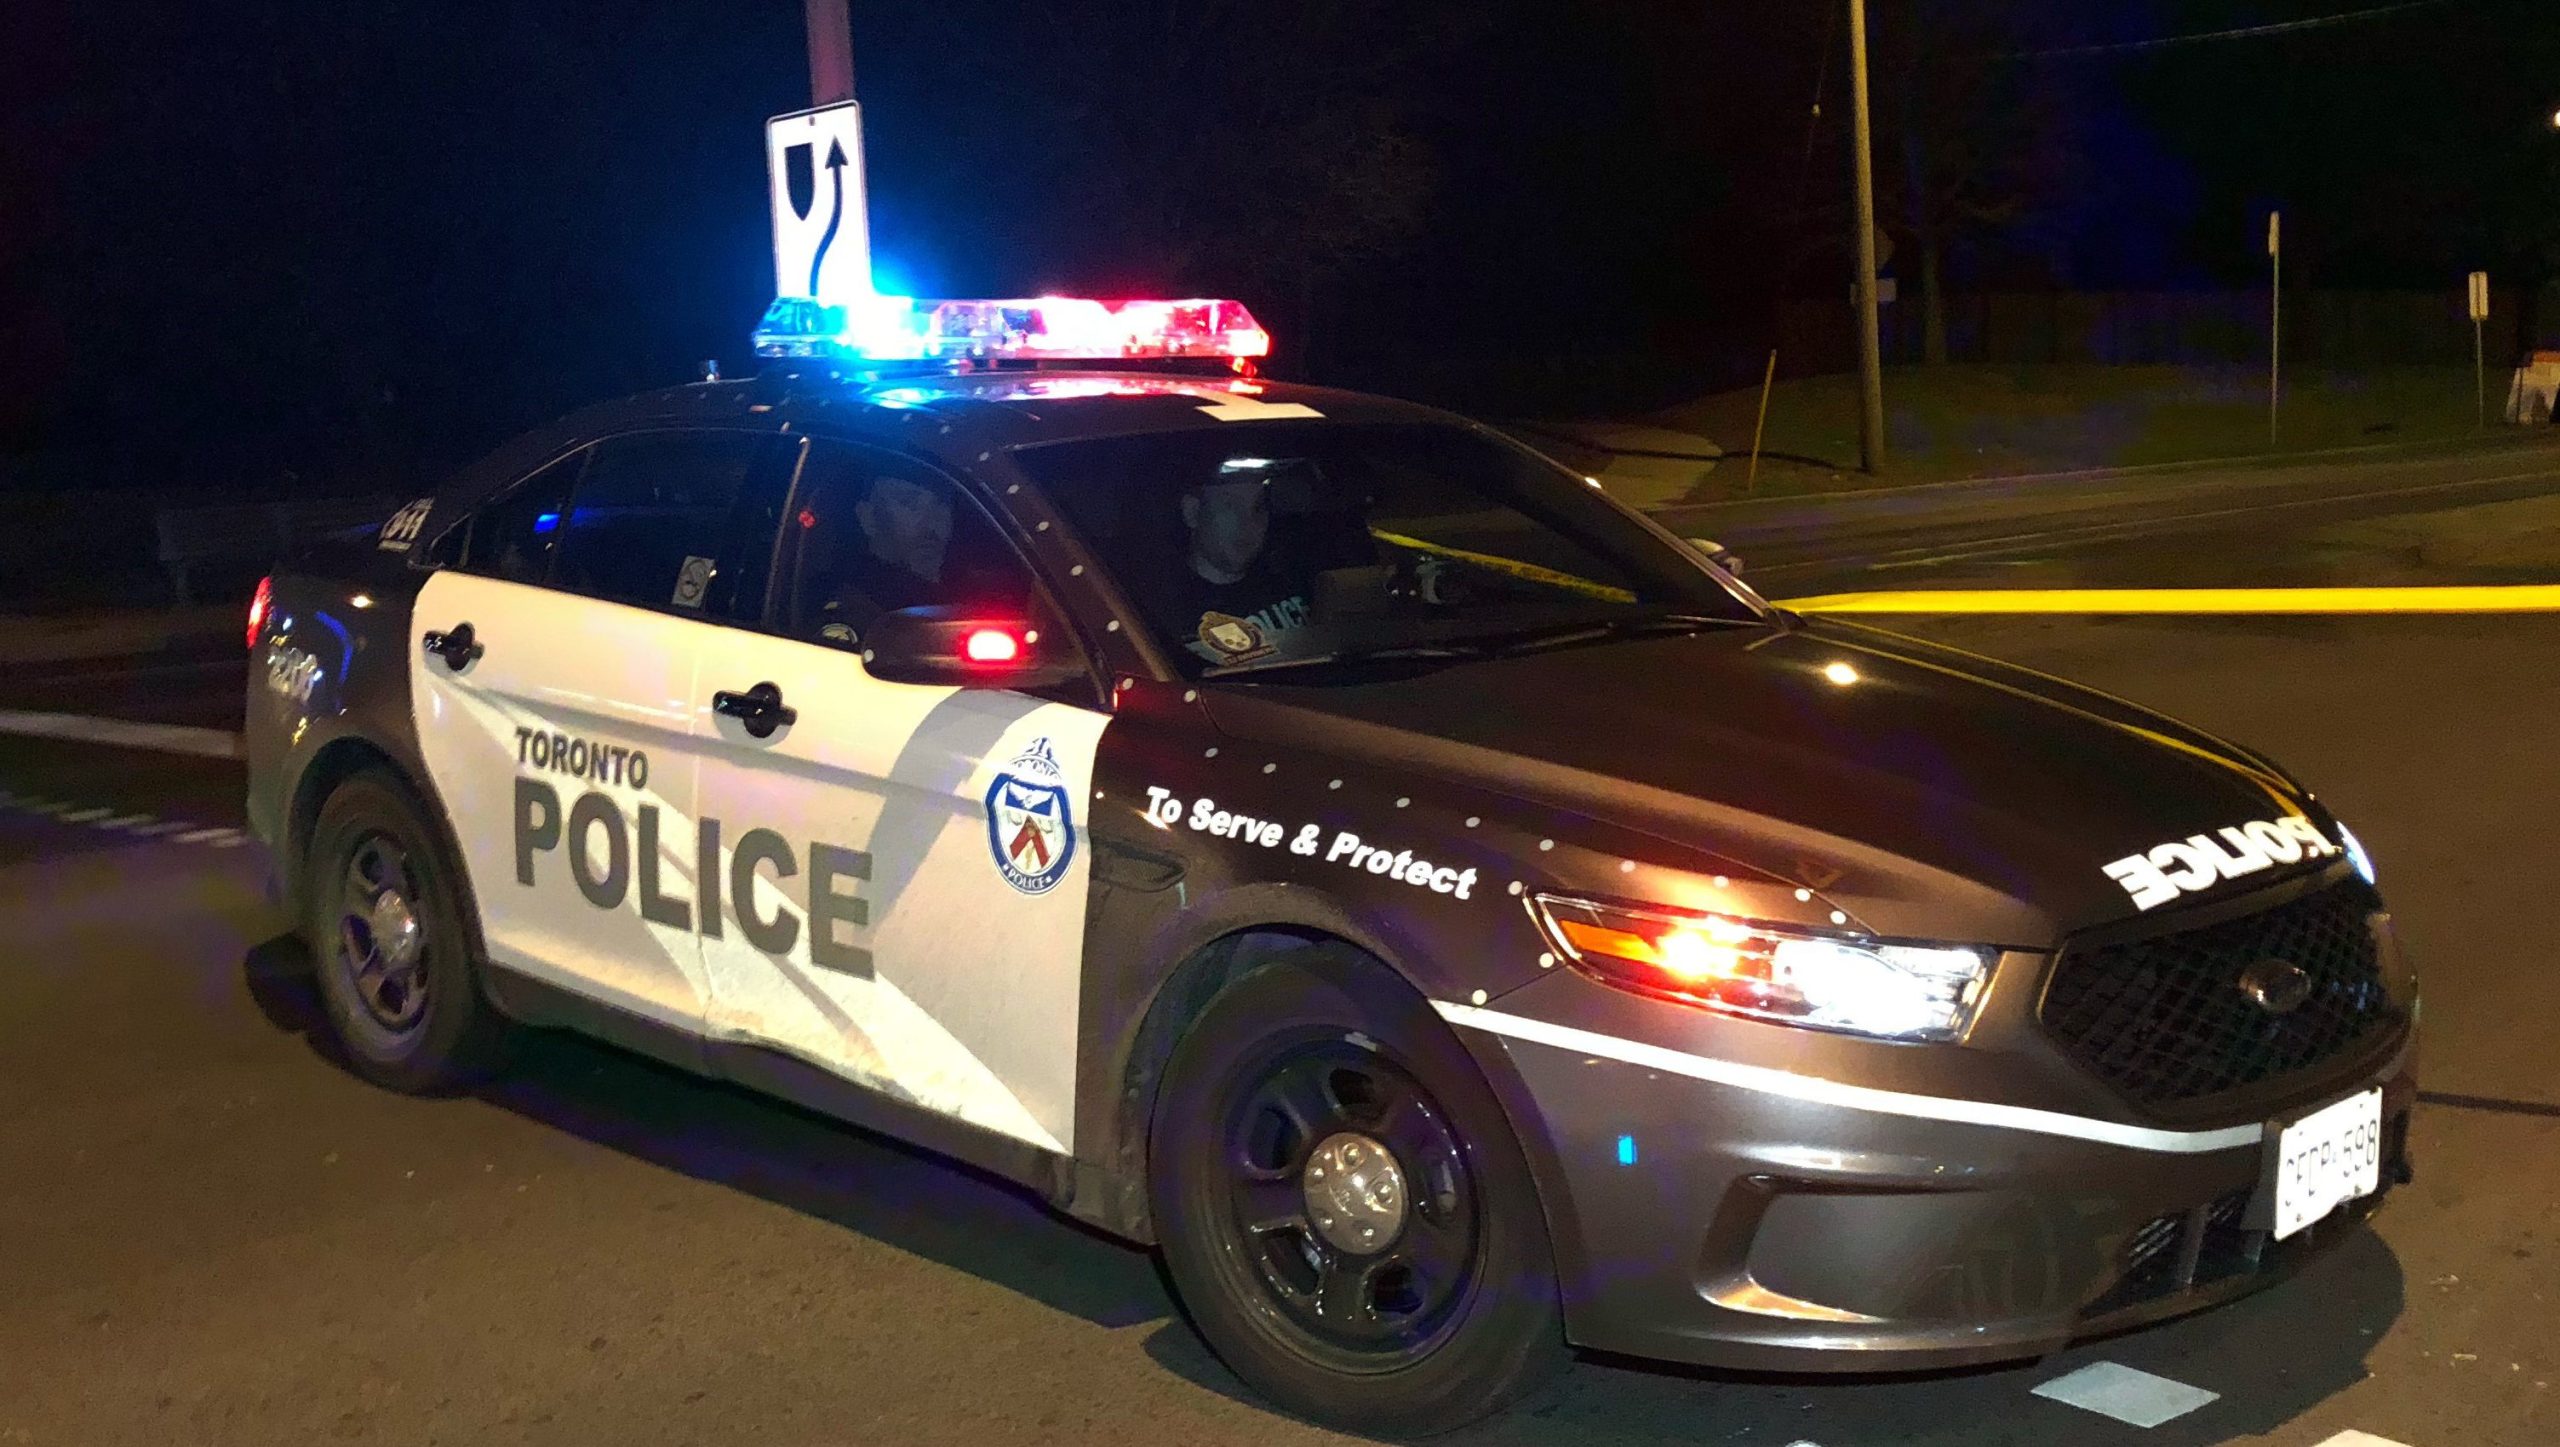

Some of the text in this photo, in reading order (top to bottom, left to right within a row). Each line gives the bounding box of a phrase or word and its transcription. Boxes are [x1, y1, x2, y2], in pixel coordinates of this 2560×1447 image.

[1245, 596, 1311, 632] OLICE
[515, 725, 649, 790] TORONTO
[1146, 785, 1478, 900] To Serve & Protect
[514, 775, 875, 982] POLICE
[1008, 868, 1046, 889] POLICE
